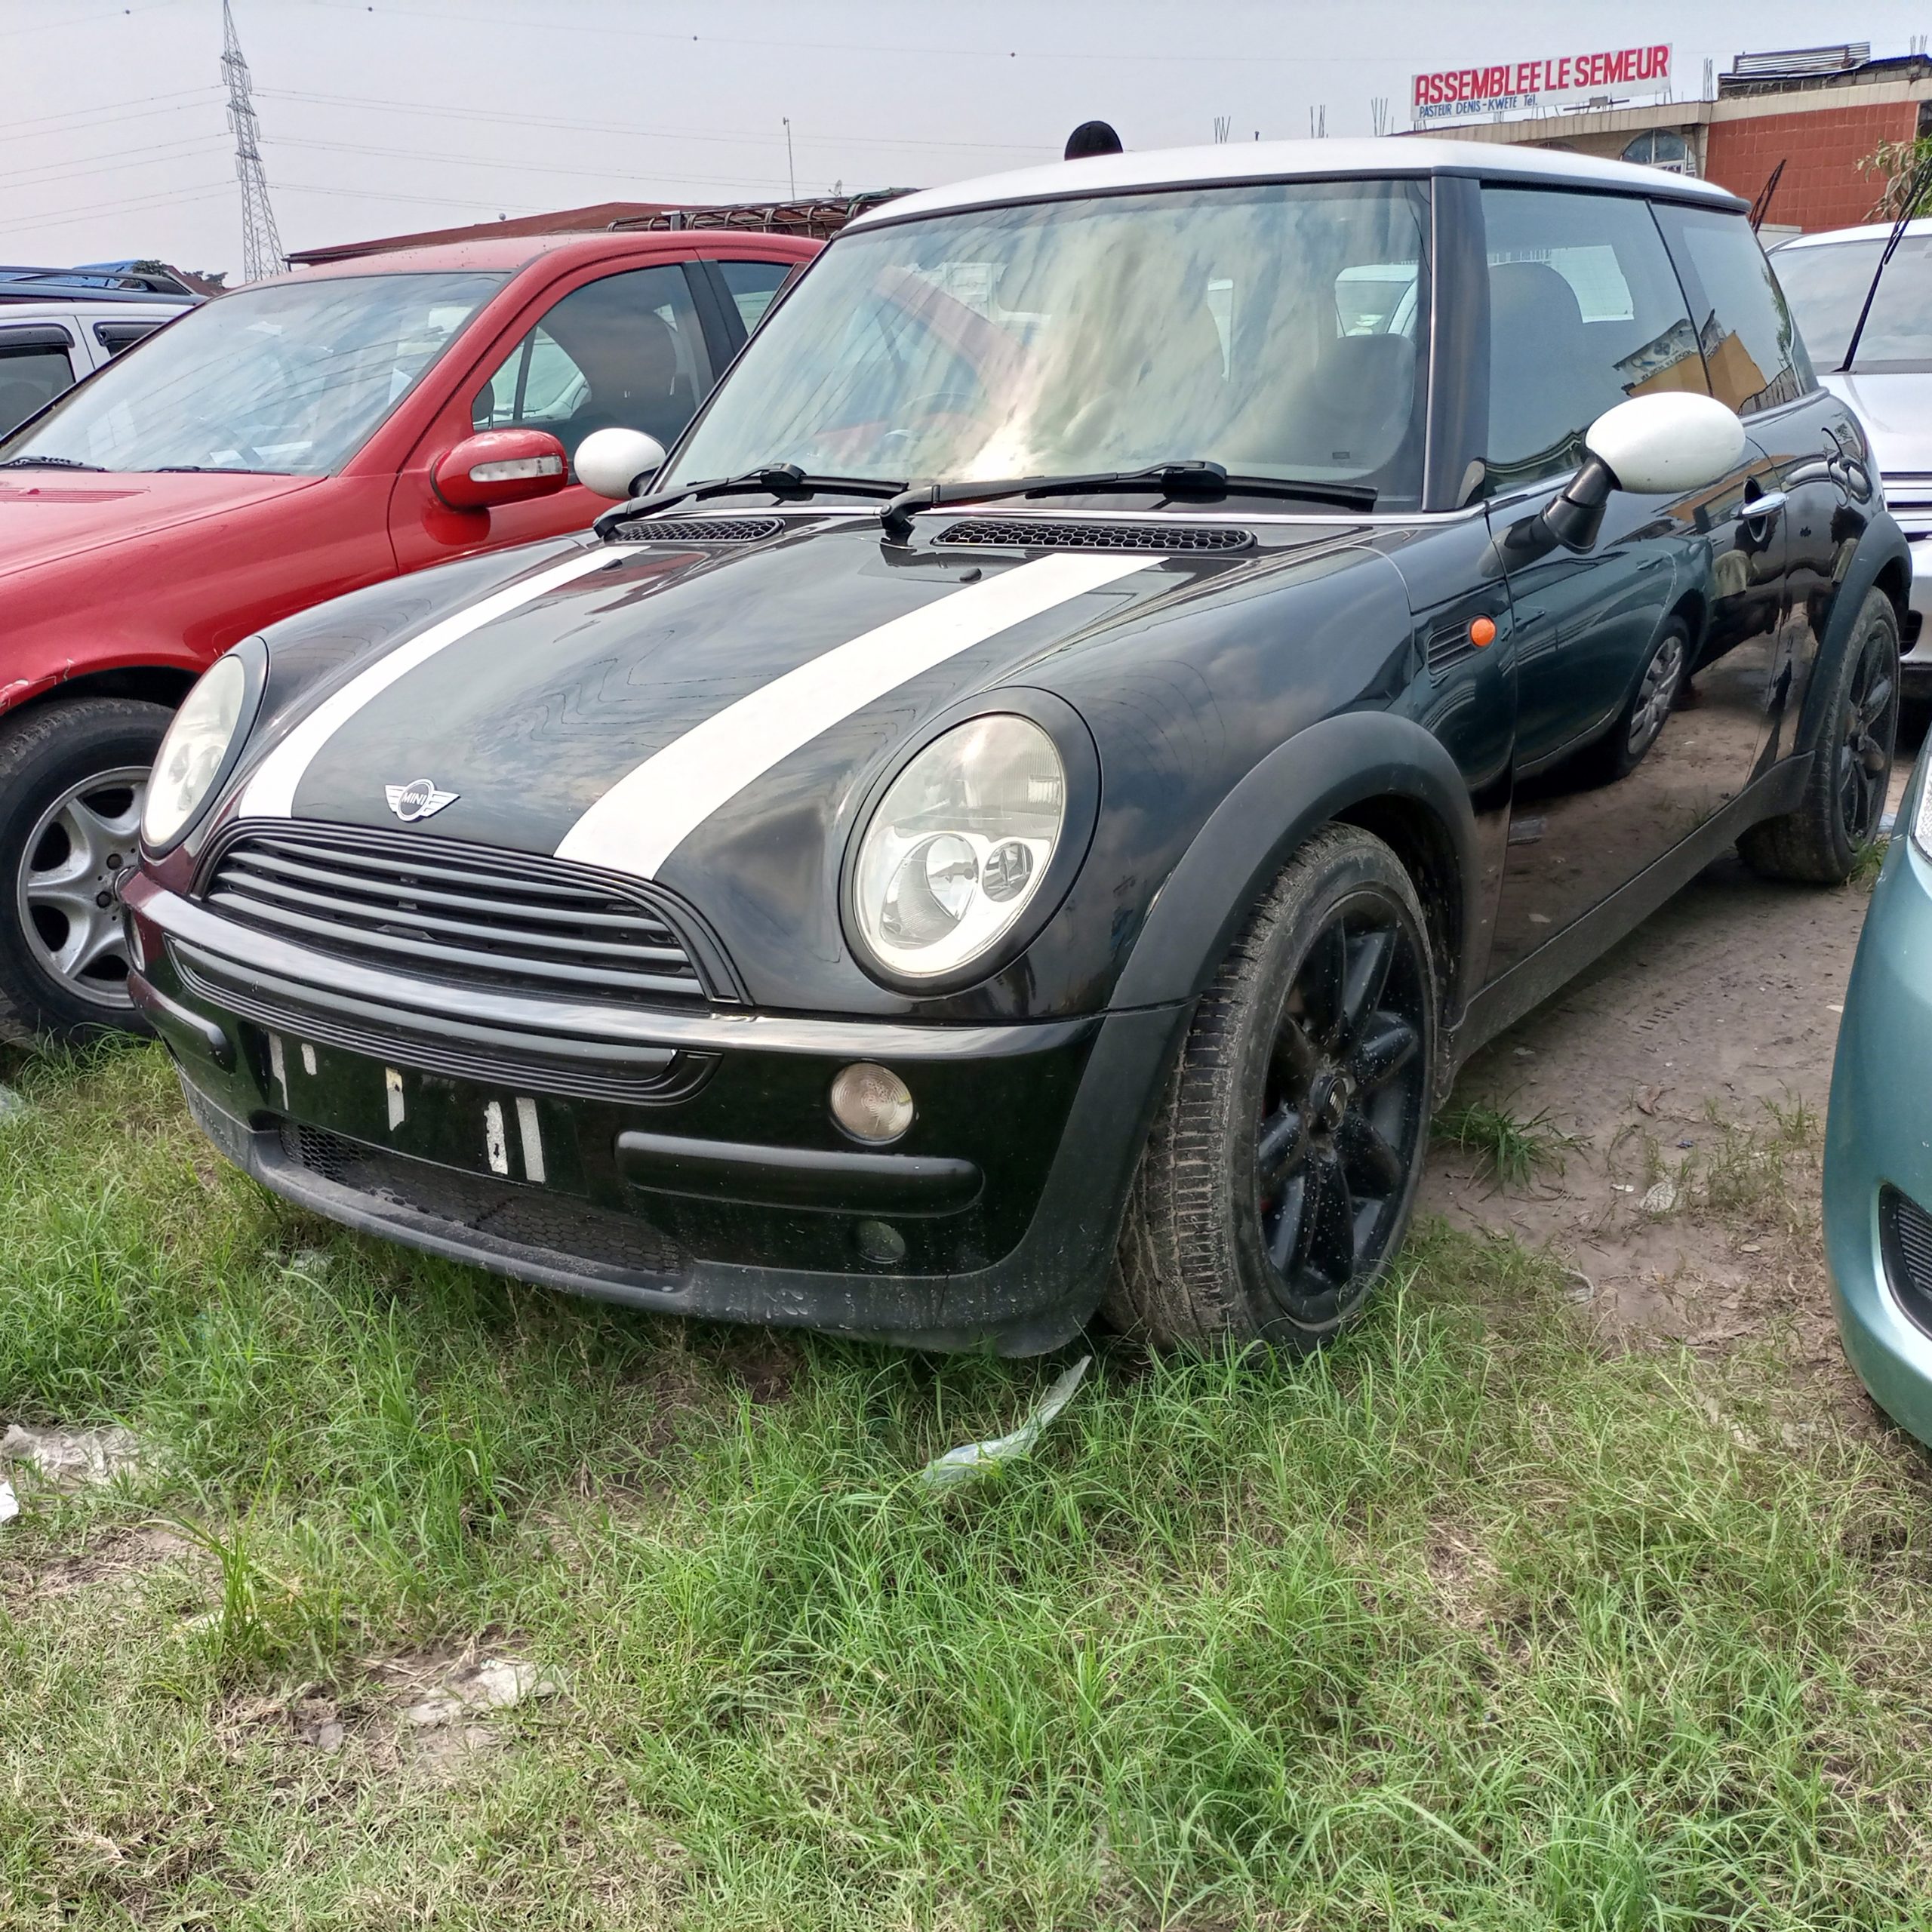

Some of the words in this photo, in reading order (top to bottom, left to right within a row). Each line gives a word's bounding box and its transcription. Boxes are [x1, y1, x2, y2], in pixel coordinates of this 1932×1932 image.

[1414, 61, 1541, 106] ASSEMBLEE
[1545, 58, 1571, 91] LE
[1574, 46, 1669, 88] SEMEUR
[1420, 103, 1452, 118] PASTEUR
[402, 792, 427, 805] MINI
